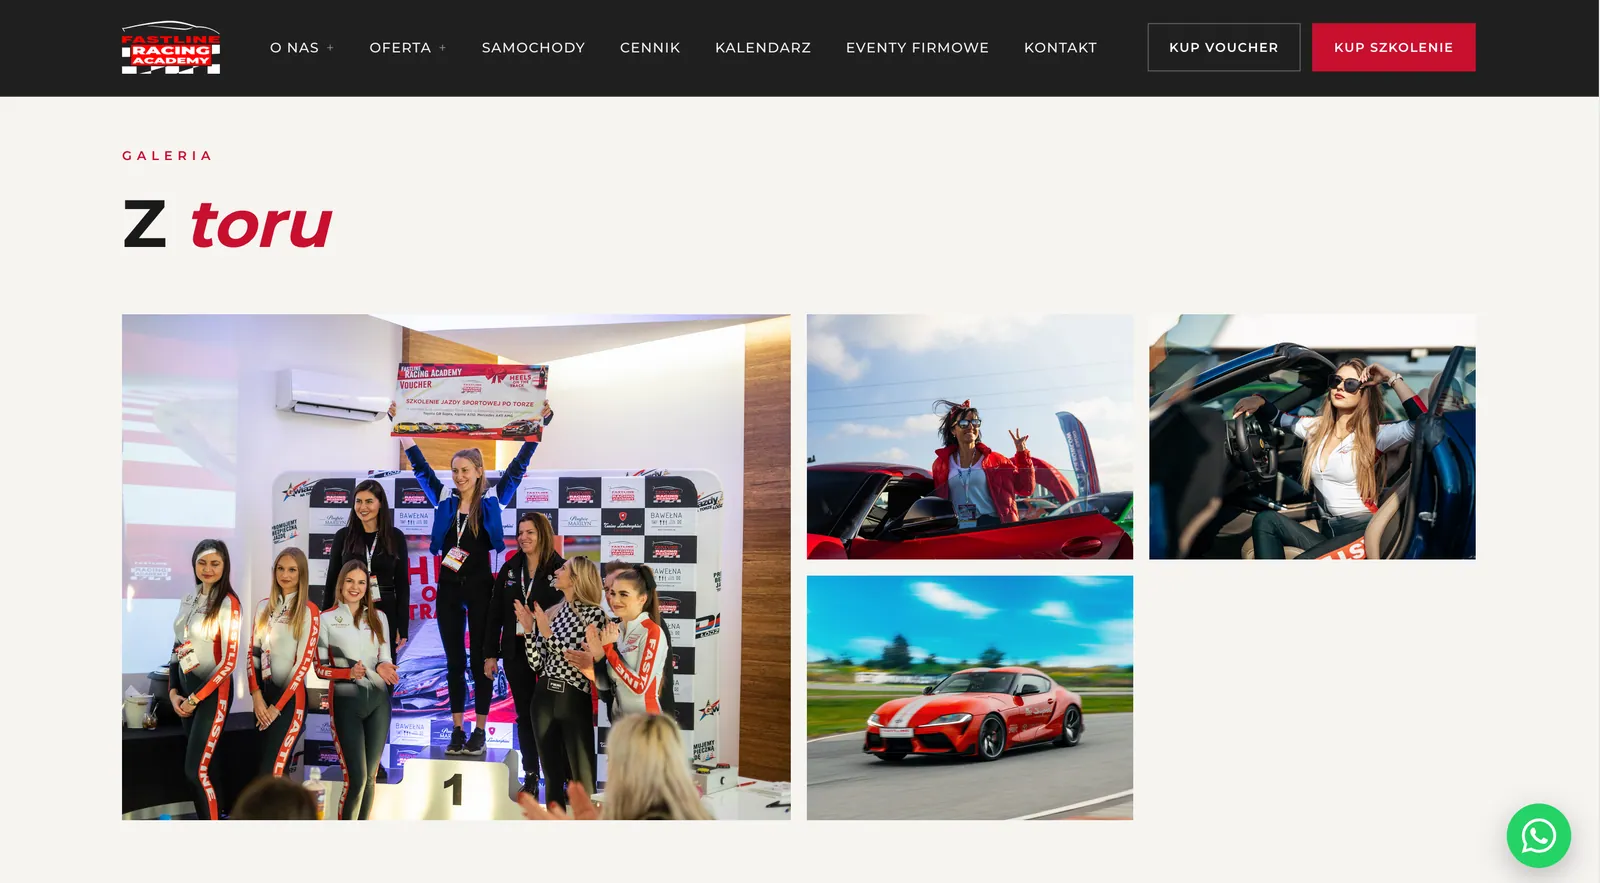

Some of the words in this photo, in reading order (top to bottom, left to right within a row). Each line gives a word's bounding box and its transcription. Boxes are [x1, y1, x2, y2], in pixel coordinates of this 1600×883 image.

[132, 46, 210, 55] RACING
[270, 41, 281, 53] O
[287, 41, 319, 53] NAS
[369, 41, 432, 53] OFERTA
[481, 41, 585, 53] SAMOCHODY
[619, 41, 681, 53] CENNIK
[715, 41, 811, 53] KALENDARZ
[846, 41, 907, 53] EVENTY
[912, 41, 989, 53] FIRMOWE
[1024, 41, 1098, 53] KONTAKT
[1169, 42, 1200, 53] KUP
[1205, 42, 1278, 53] VOUCHER
[1334, 42, 1365, 53] KUP
[1370, 42, 1453, 53] SZKOLENIE
[122, 150, 212, 161] GALERIA
[123, 200, 167, 248] Z
[191, 202, 334, 249] toru
[405, 370, 429, 378] RACING
[431, 368, 462, 377] ACADEMY
[400, 381, 432, 389] VOUCHER
[290, 616, 319, 692] FASTLINE
[274, 708, 304, 777] FASTL
[693, 740, 715, 749] MUJEMY
[200, 699, 227, 801] FASTLINE
[693, 746, 715, 755] PIECZNĄ
[444, 773, 462, 806] 1
